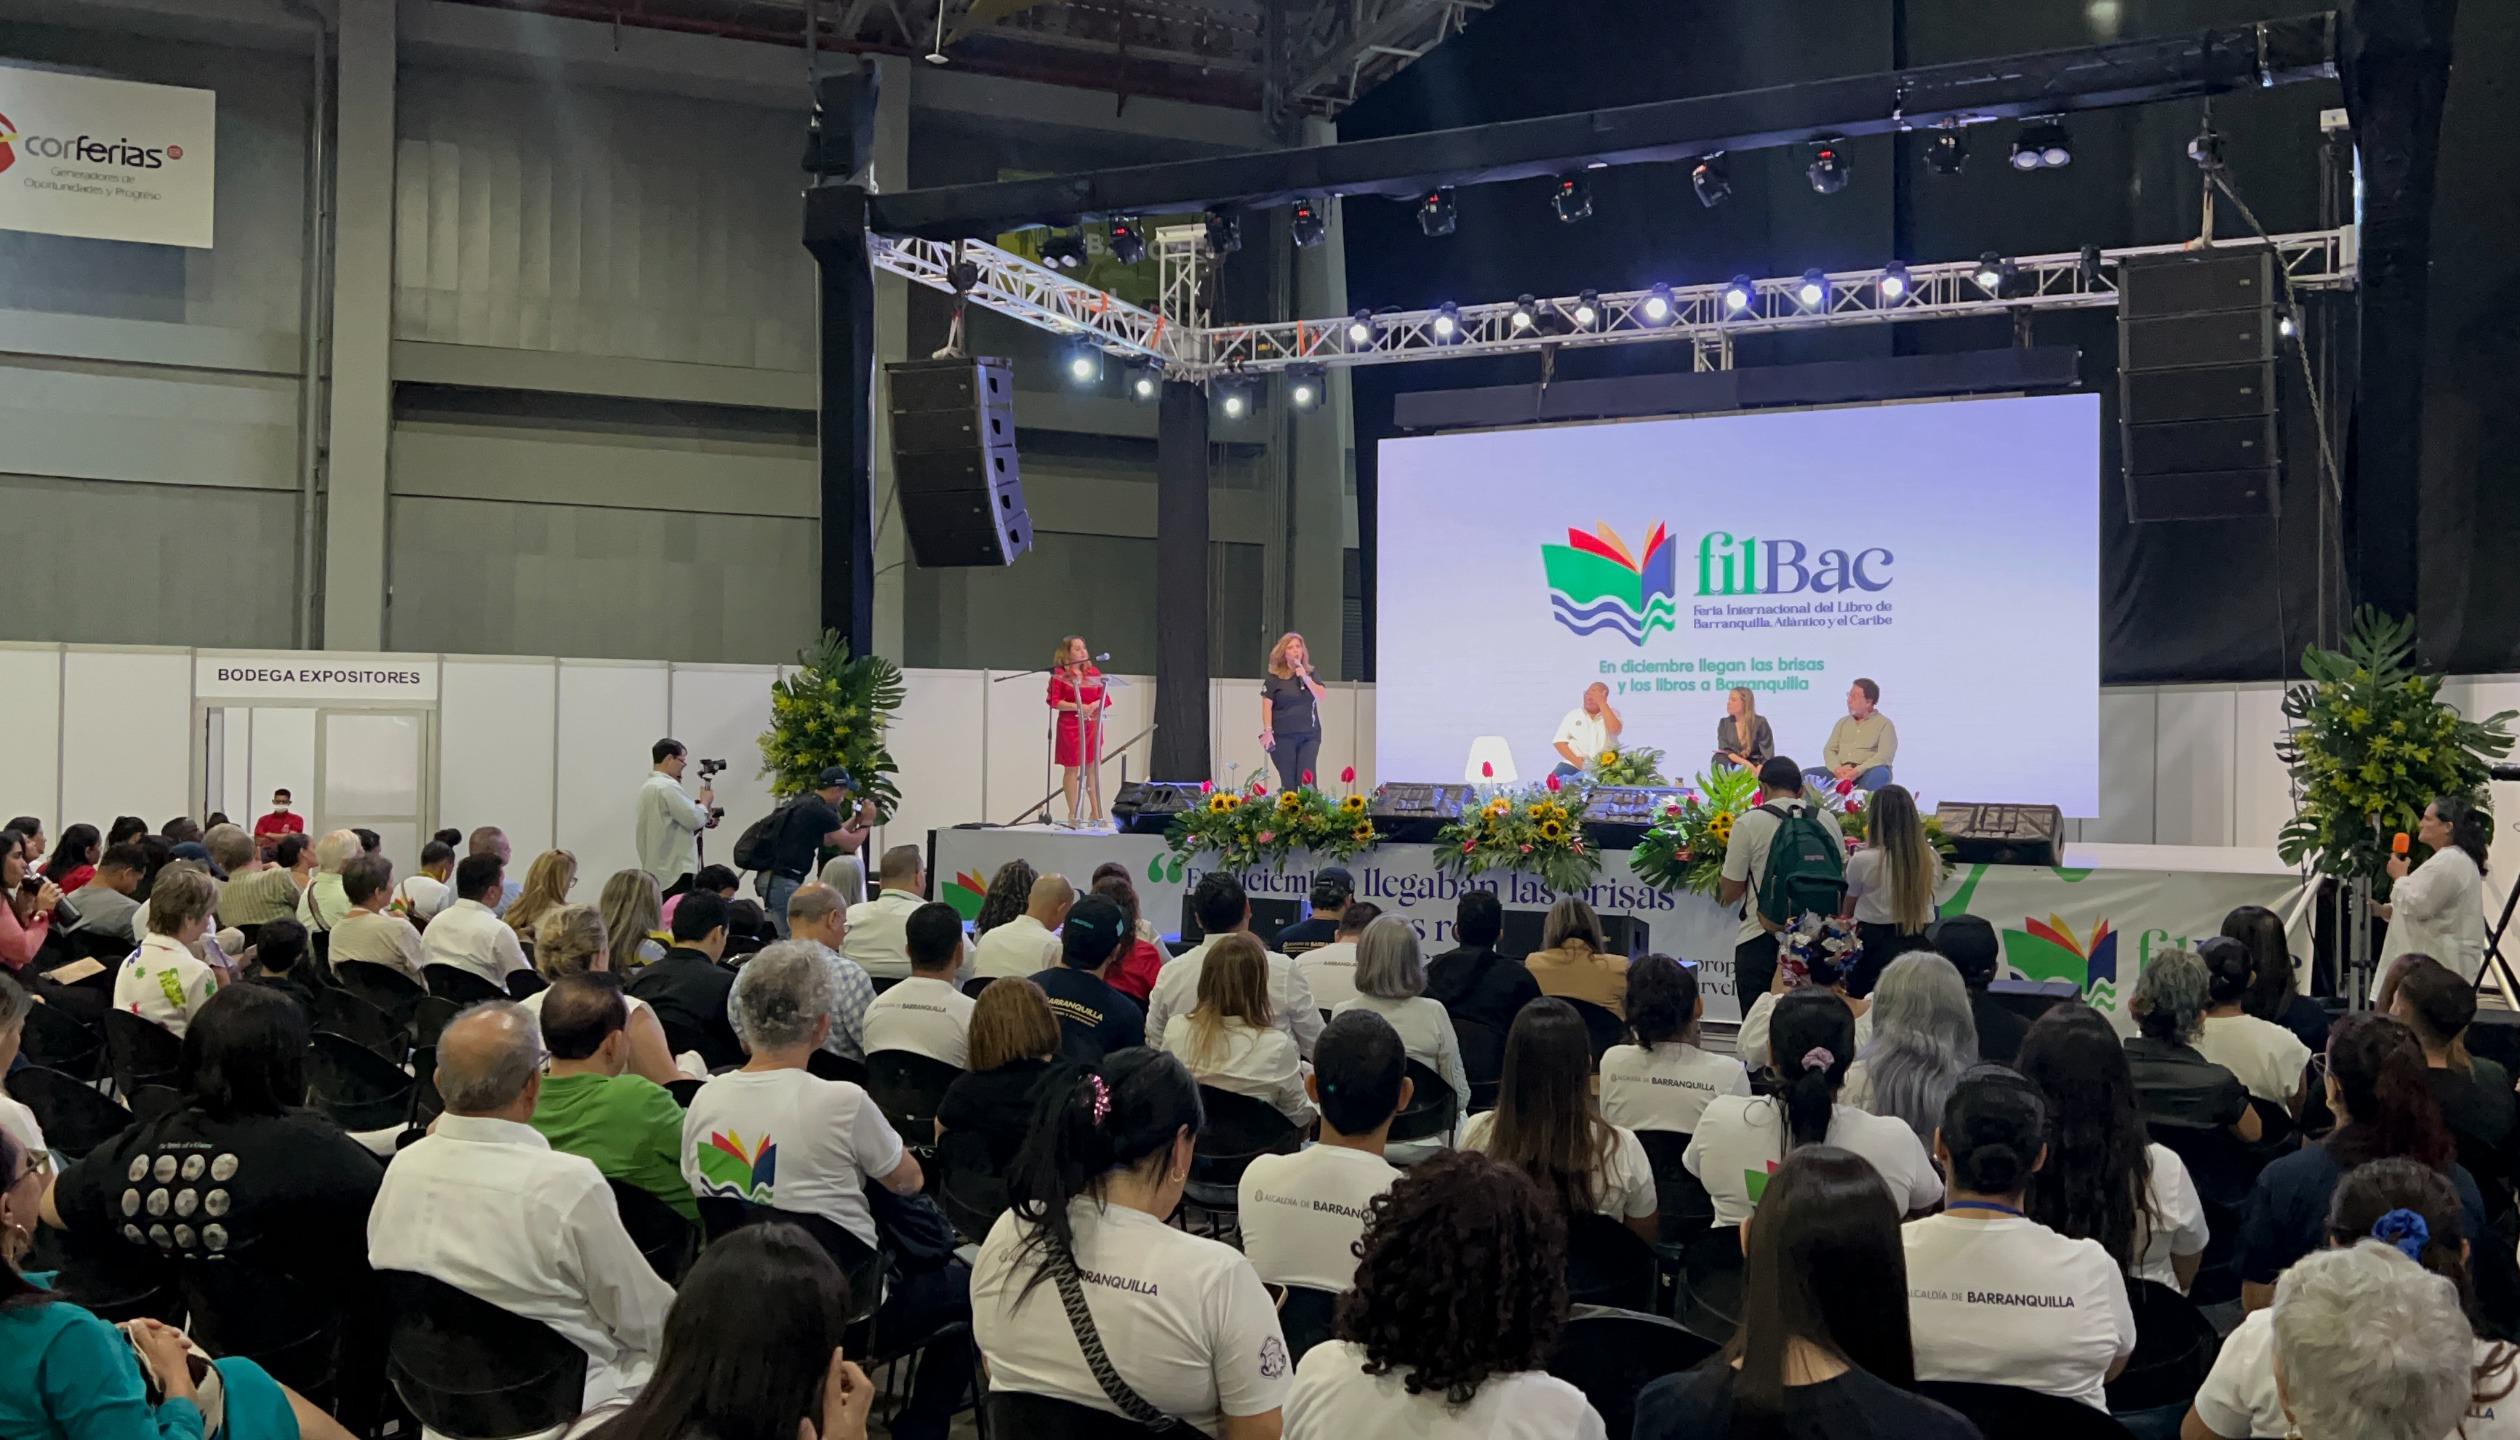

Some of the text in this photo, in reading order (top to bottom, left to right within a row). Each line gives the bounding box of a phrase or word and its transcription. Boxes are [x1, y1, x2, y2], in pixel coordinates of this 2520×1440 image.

[25, 135, 162, 169] corferias
[51, 166, 136, 184] Generadores de
[24, 177, 103, 196] Oportunidades
[1693, 531, 1894, 597] filBac
[1693, 600, 1892, 616] Feria Internacional del Libro de
[1827, 618, 1837, 629] y
[1837, 614, 1848, 626] el
[1849, 614, 1893, 626] Caribe
[1599, 657, 1825, 676] En diciembre llegan las brisas
[217, 668, 421, 685] BODEGA EXPOSITORES
[1617, 680, 1627, 695] y
[1630, 678, 1651, 692] los
[1655, 677, 1697, 692] libros
[1700, 681, 1711, 691] a
[1048, 997, 1104, 1022] ARRANQUILLA
[1651, 1076, 1716, 1092] BARRANQUILLA
[1079, 1268, 1158, 1297] RRANQUILLA
[1951, 1292, 1963, 1302] DE
[1966, 1290, 2075, 1309] BARRANQUILLA
